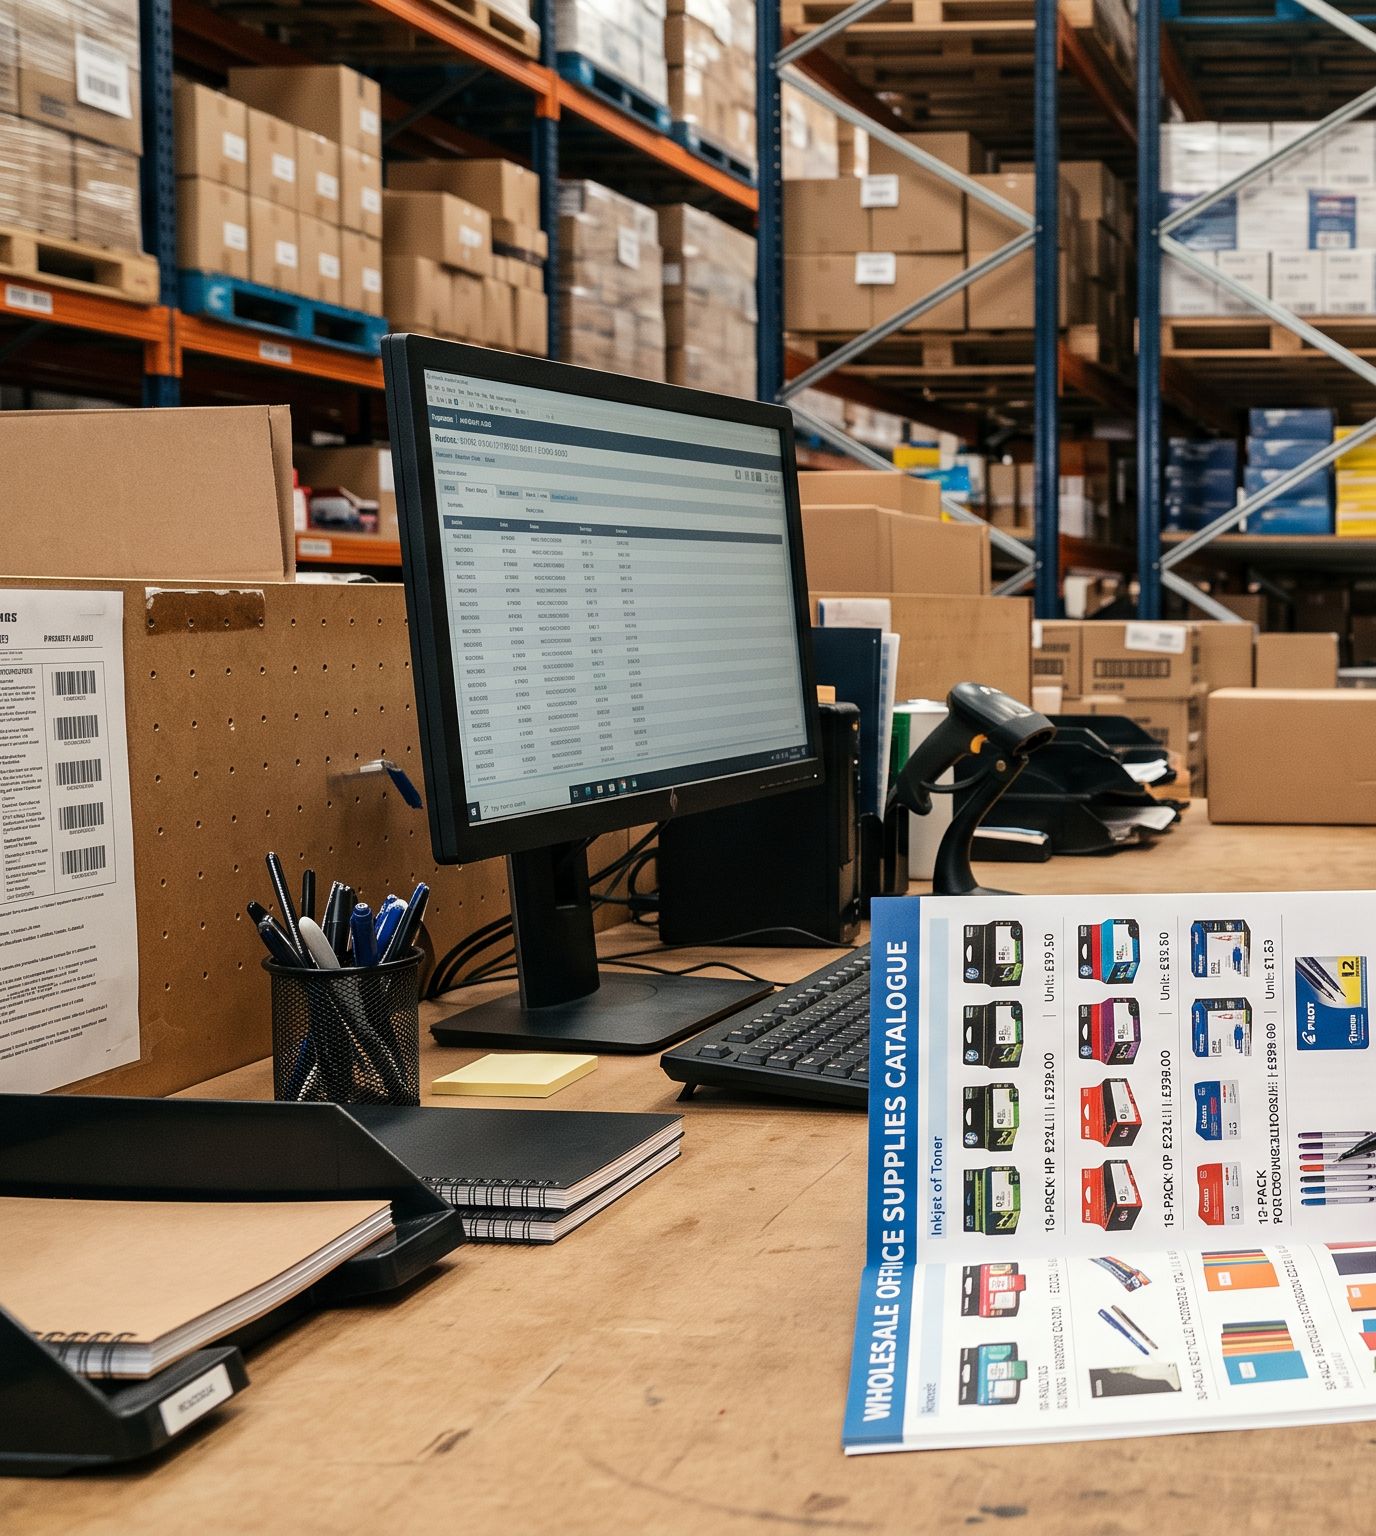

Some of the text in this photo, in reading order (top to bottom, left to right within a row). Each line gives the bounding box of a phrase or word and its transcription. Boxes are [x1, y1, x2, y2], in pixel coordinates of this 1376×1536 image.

[1342, 961, 1354, 977] 12
[885, 941, 907, 1088] CATALOGUE
[882, 1096, 906, 1222] SUPPLIES
[930, 1136, 942, 1174] Toner
[1044, 1157, 1055, 1174] HP
[930, 1178, 942, 1192] of
[863, 1304, 900, 1422] WHOLESALE
